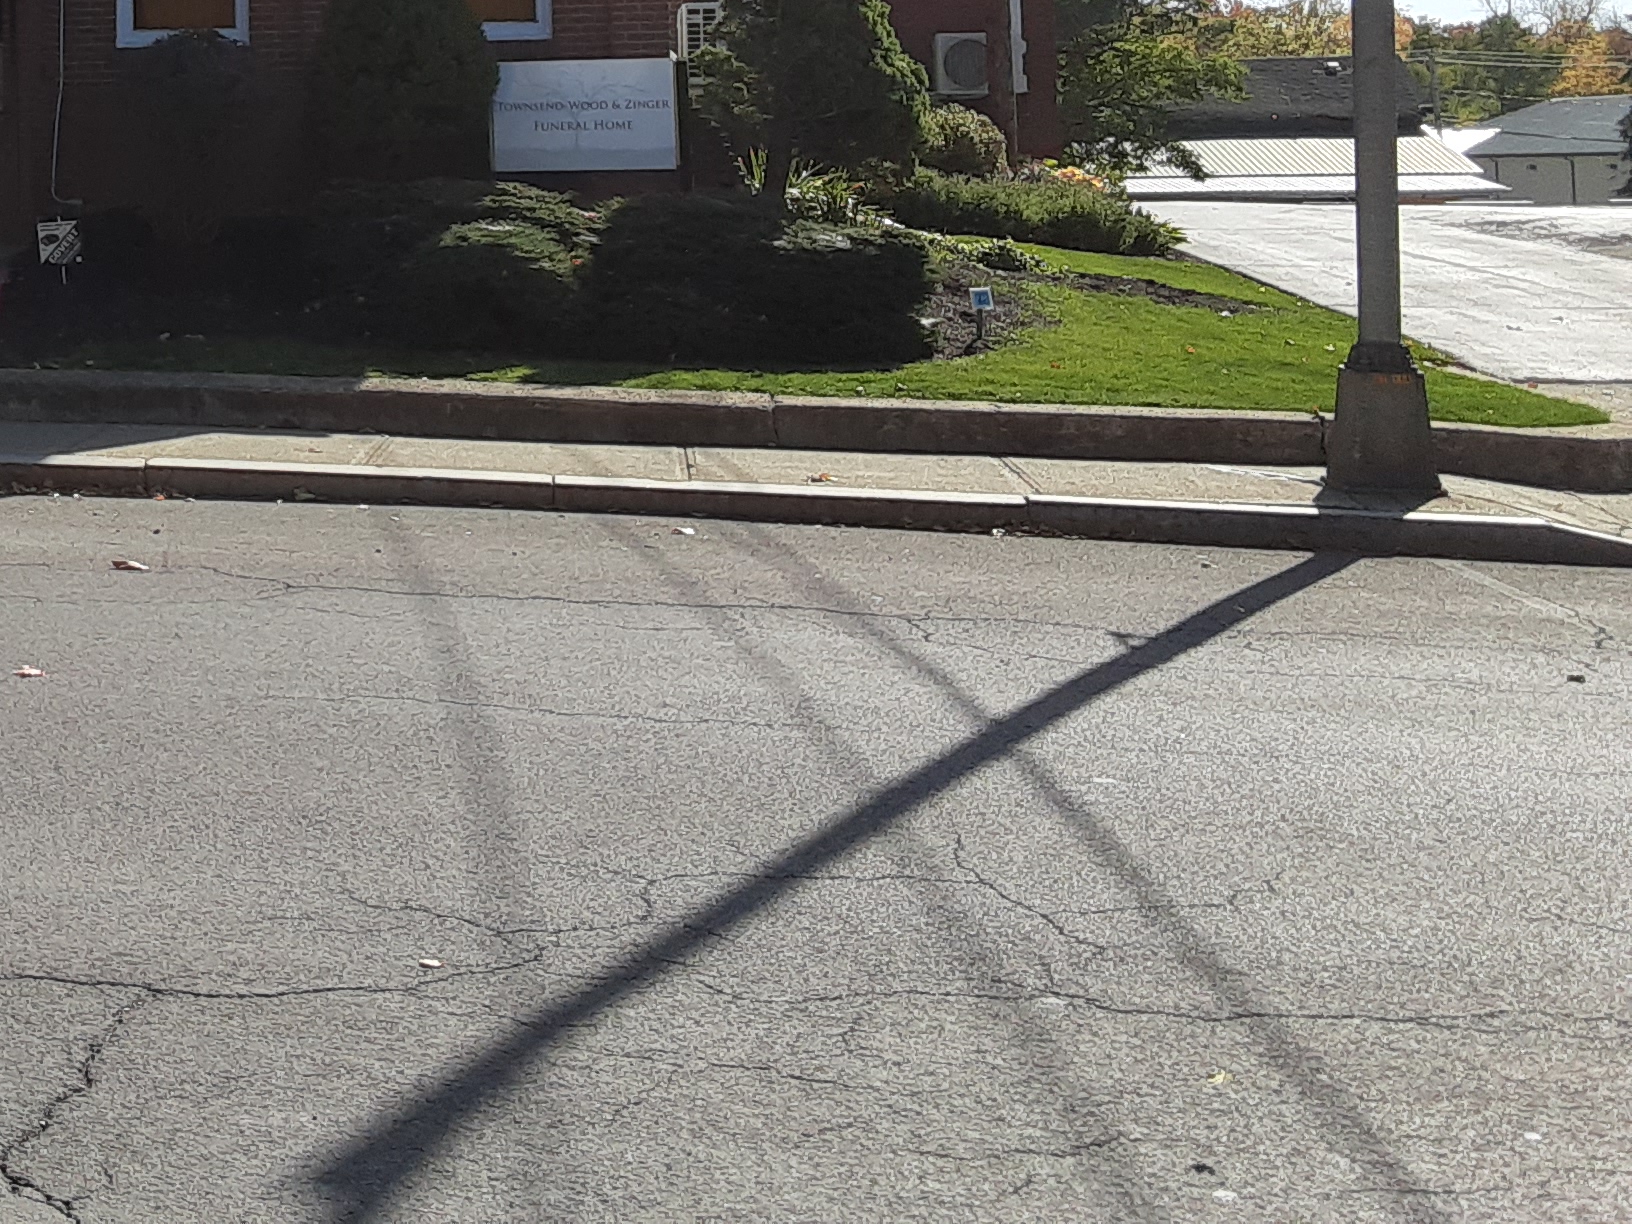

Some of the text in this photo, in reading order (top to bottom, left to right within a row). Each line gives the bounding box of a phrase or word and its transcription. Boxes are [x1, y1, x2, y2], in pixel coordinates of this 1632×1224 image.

[612, 99, 621, 109] &
[625, 99, 671, 110] ZINGER
[534, 120, 633, 132] FUNERAL HOME
